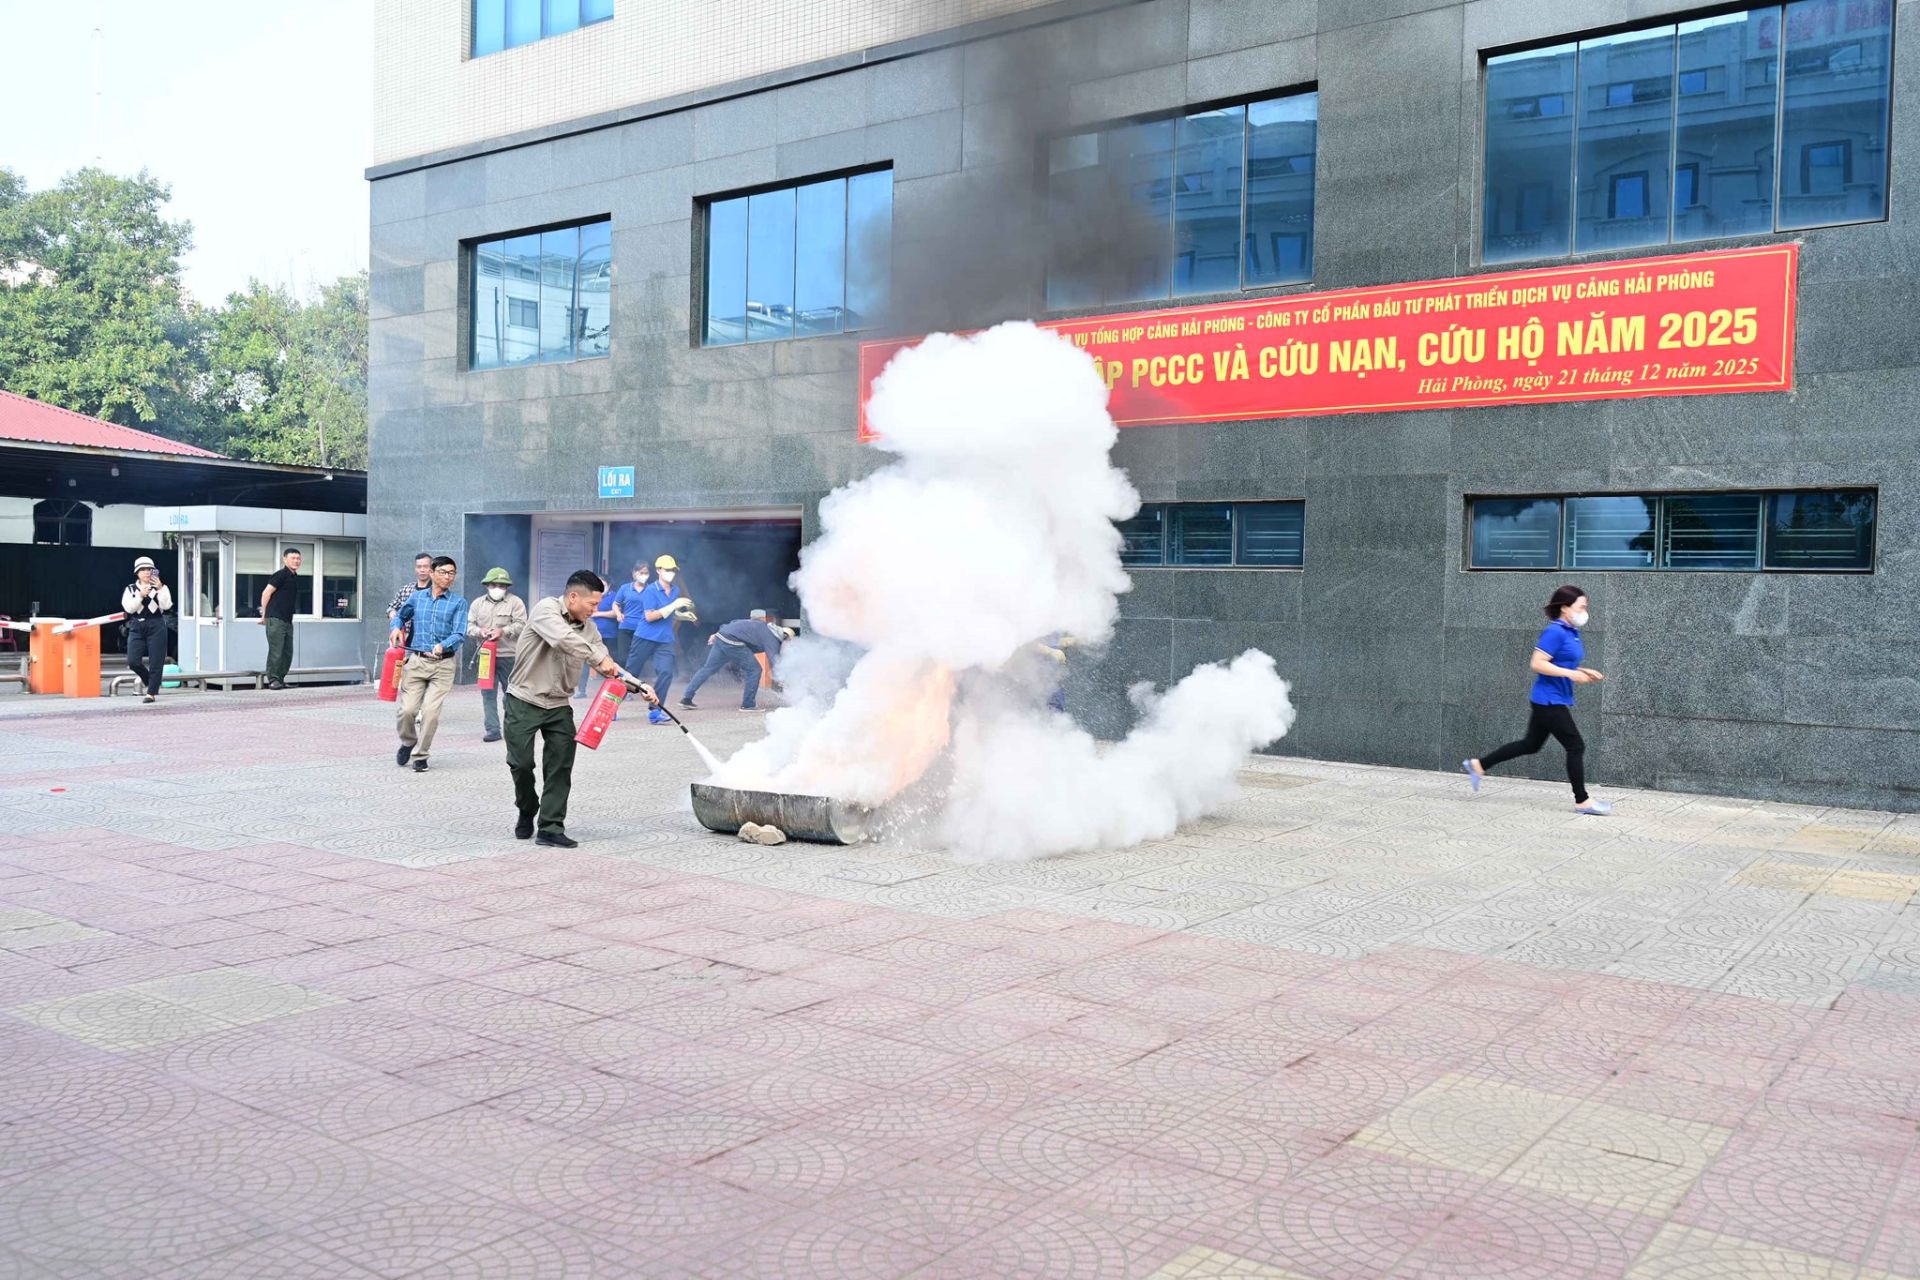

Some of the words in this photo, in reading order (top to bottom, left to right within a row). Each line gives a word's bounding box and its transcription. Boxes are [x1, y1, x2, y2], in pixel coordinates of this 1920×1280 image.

[1074, 333, 1088, 349] VỤ
[1122, 326, 1144, 344] HỢP
[1147, 321, 1178, 339] CẢNG
[1181, 317, 1200, 336] HẢI
[1204, 313, 1245, 334] PHÒNG
[1256, 310, 1291, 329] CÔNG
[1294, 310, 1309, 326] TY
[1312, 302, 1330, 324] CỔ
[1333, 299, 1370, 322] PHẦN
[1373, 296, 1401, 318] ĐẦU
[1405, 296, 1423, 315] TƯ
[1425, 292, 1462, 313] PHÁT
[1465, 285, 1509, 310] TRIỂN
[1512, 286, 1548, 308] DỊCH
[1552, 283, 1572, 304] VỤ
[1576, 276, 1619, 299] CẢNG
[1624, 271, 1652, 295] HẢI
[1656, 268, 1715, 292] PHÒNG
[1132, 353, 1204, 388] PCCC
[1213, 342, 1250, 383] VÀ
[1259, 337, 1319, 379] CỨU
[1329, 336, 1406, 379] NẠN,
[1418, 323, 1486, 367] CỨU
[1497, 316, 1545, 367] HỘ
[1556, 310, 1646, 356] NĂM
[1658, 306, 1758, 350] 2025
[1417, 375, 1448, 394] Hải
[1451, 374, 1508, 394] Phòng,
[1512, 370, 1553, 391] ngày
[1557, 368, 1578, 385] 21
[1582, 365, 1634, 385] tháng
[1638, 363, 1662, 381] 12
[1665, 361, 1707, 379] năm
[1711, 357, 1760, 376] 2025
[619, 473, 631, 486] RA
